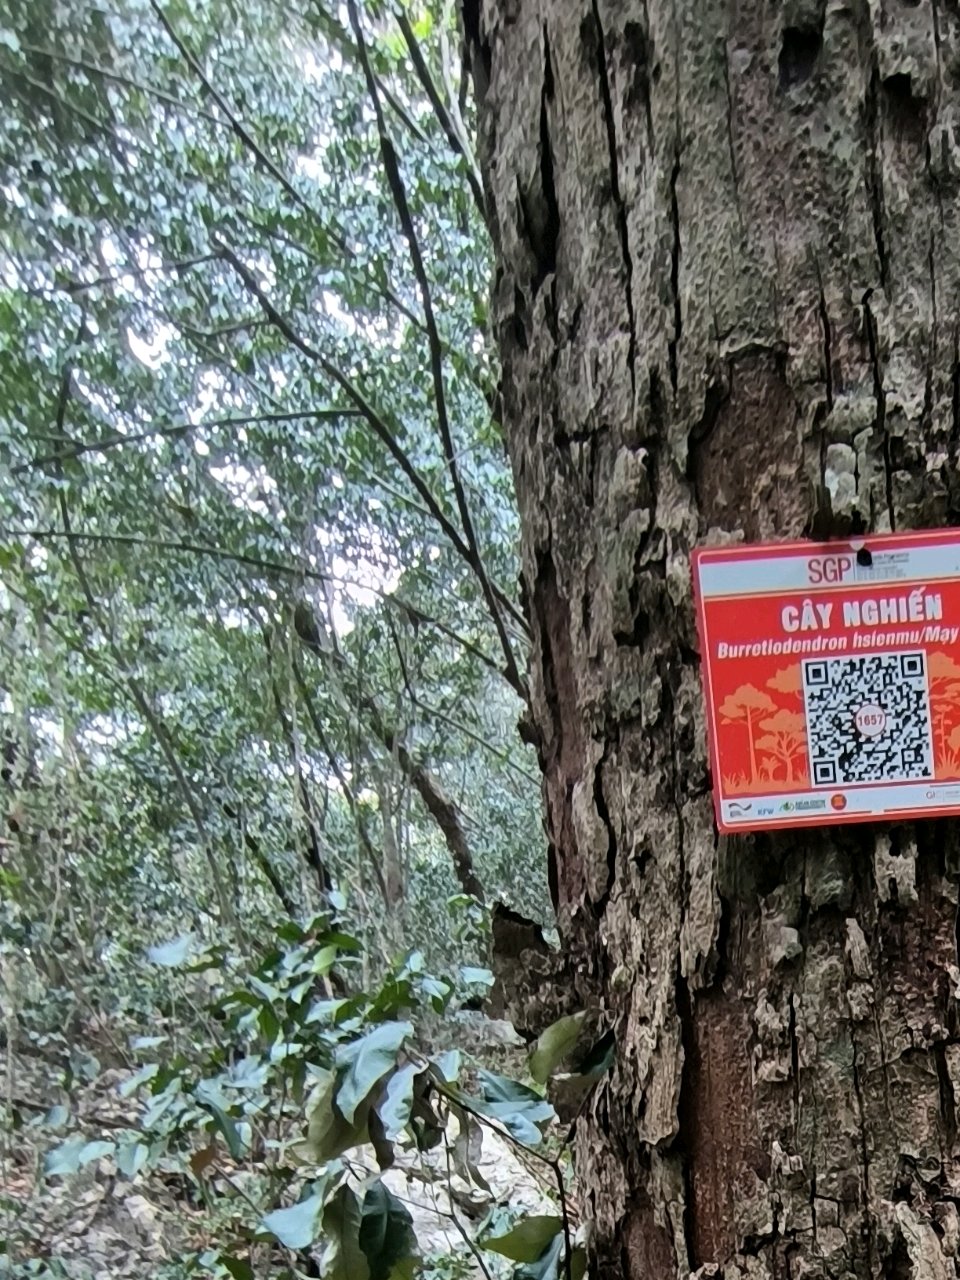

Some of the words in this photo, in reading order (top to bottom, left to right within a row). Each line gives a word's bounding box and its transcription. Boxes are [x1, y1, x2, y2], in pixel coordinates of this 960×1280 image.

[808, 557, 851, 583] SGP
[781, 598, 833, 632] CÂY
[843, 586, 942, 628] NGHIẾN
[717, 635, 847, 659] Burretiodendron
[857, 714, 883, 726] 1657
